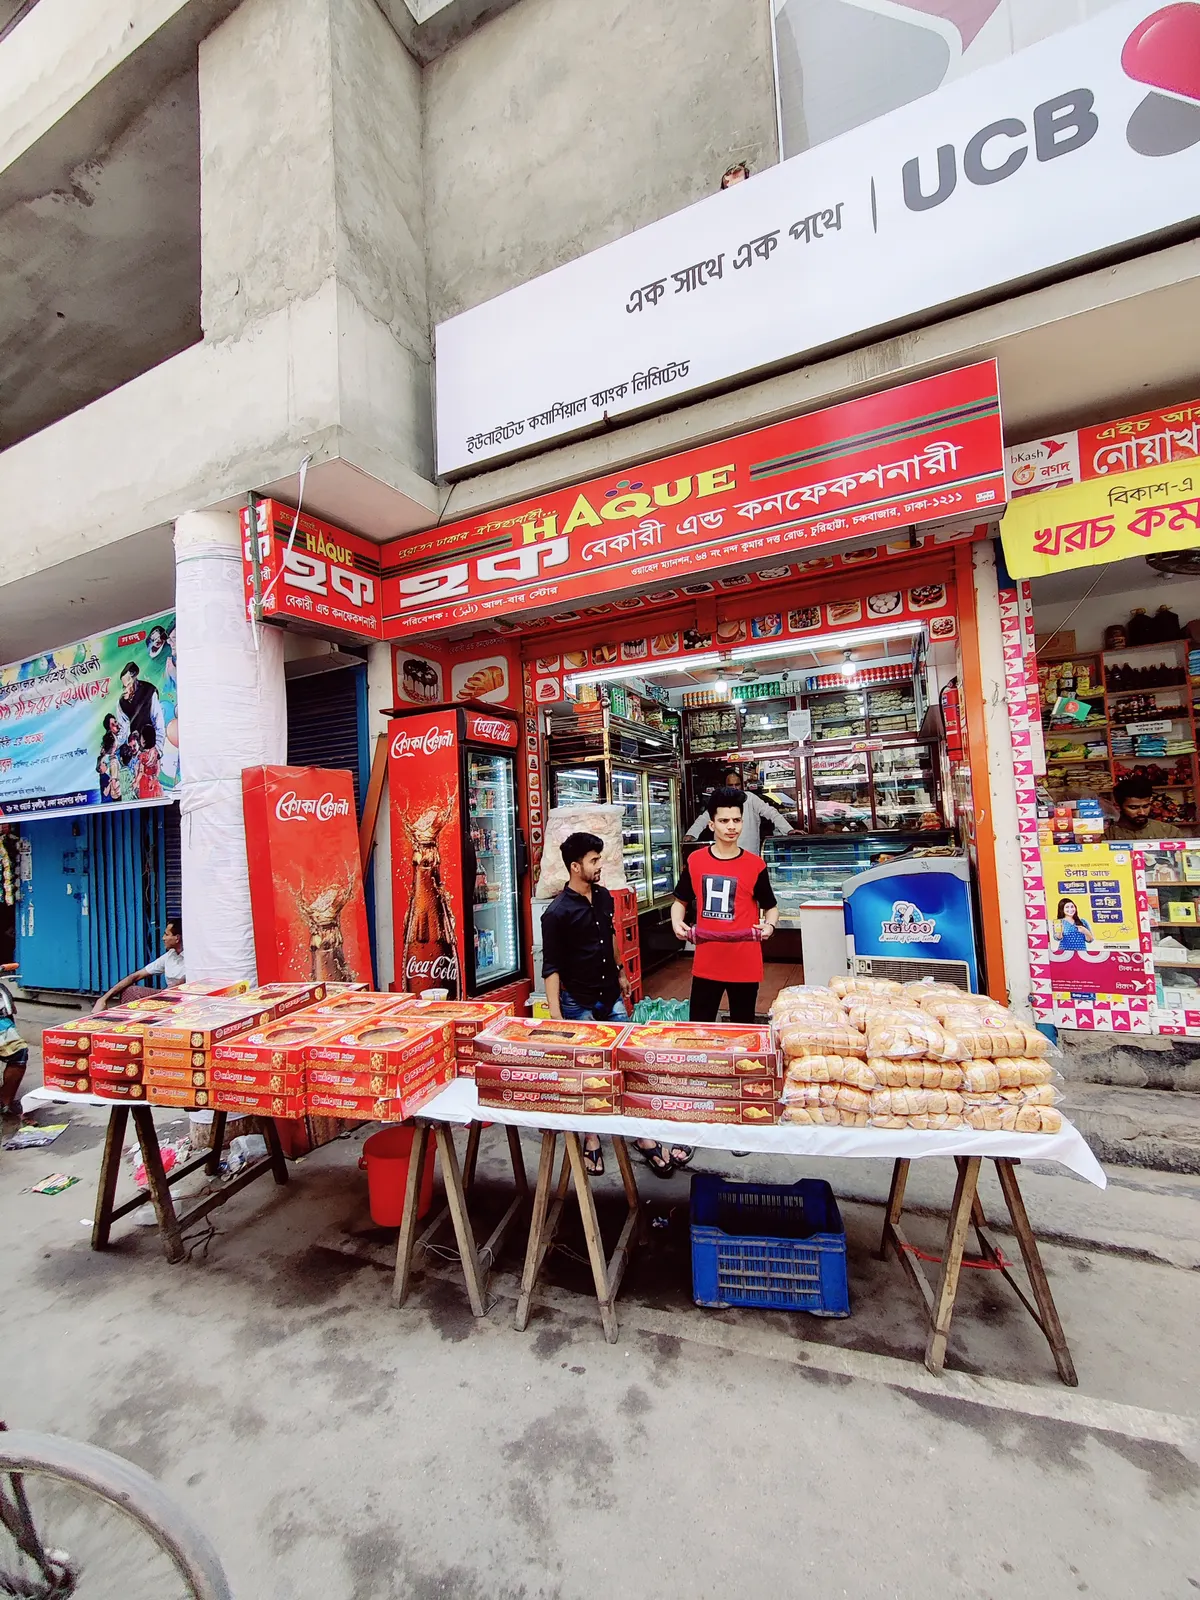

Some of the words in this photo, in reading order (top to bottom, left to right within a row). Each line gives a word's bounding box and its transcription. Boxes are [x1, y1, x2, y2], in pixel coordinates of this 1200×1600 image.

[902, 88, 1099, 211] UCB
[625, 278, 667, 313] এক
[672, 253, 725, 294] সাথে
[733, 230, 780, 270] এক
[789, 202, 844, 244] পথে
[466, 420, 524, 454] ইউনাইটেড
[528, 393, 587, 430] কমার্শিয়াল
[591, 385, 628, 411] ব্যাংক
[631, 360, 691, 395] লিমিটেড
[1096, 418, 1152, 439] এইচ
[1010, 449, 1044, 464] bKash
[1040, 461, 1071, 476] নগদ
[521, 463, 737, 545] HAQUE
[581, 519, 666, 561] বেকারী
[676, 507, 724, 537] এন্ড
[733, 441, 964, 522] কনফেকশনারী
[1107, 477, 1193, 507] বিকাশ-এ
[436, 531, 469, 547] ঢাকার
[711, 549, 722, 558] নং
[741, 537, 764, 552] কুমার
[766, 535, 781, 545] দত্ত
[783, 528, 808, 541] রোড,
[852, 507, 901, 526] চকবাজার,
[904, 491, 963, 513] ঢাকা-১২১১
[1033, 515, 1116, 555] খরচ
[305, 529, 353, 566] HAQUE
[283, 548, 375, 607] হক
[400, 537, 569, 608] হক
[286, 594, 313, 612] বেকারী
[529, 586, 558, 600] স্টোর
[473, 717, 511, 742] Coca-Cola
[706, 877, 731, 912] H
[883, 922, 932, 934] IGLOO
[406, 956, 458, 981] Coca-Cola
